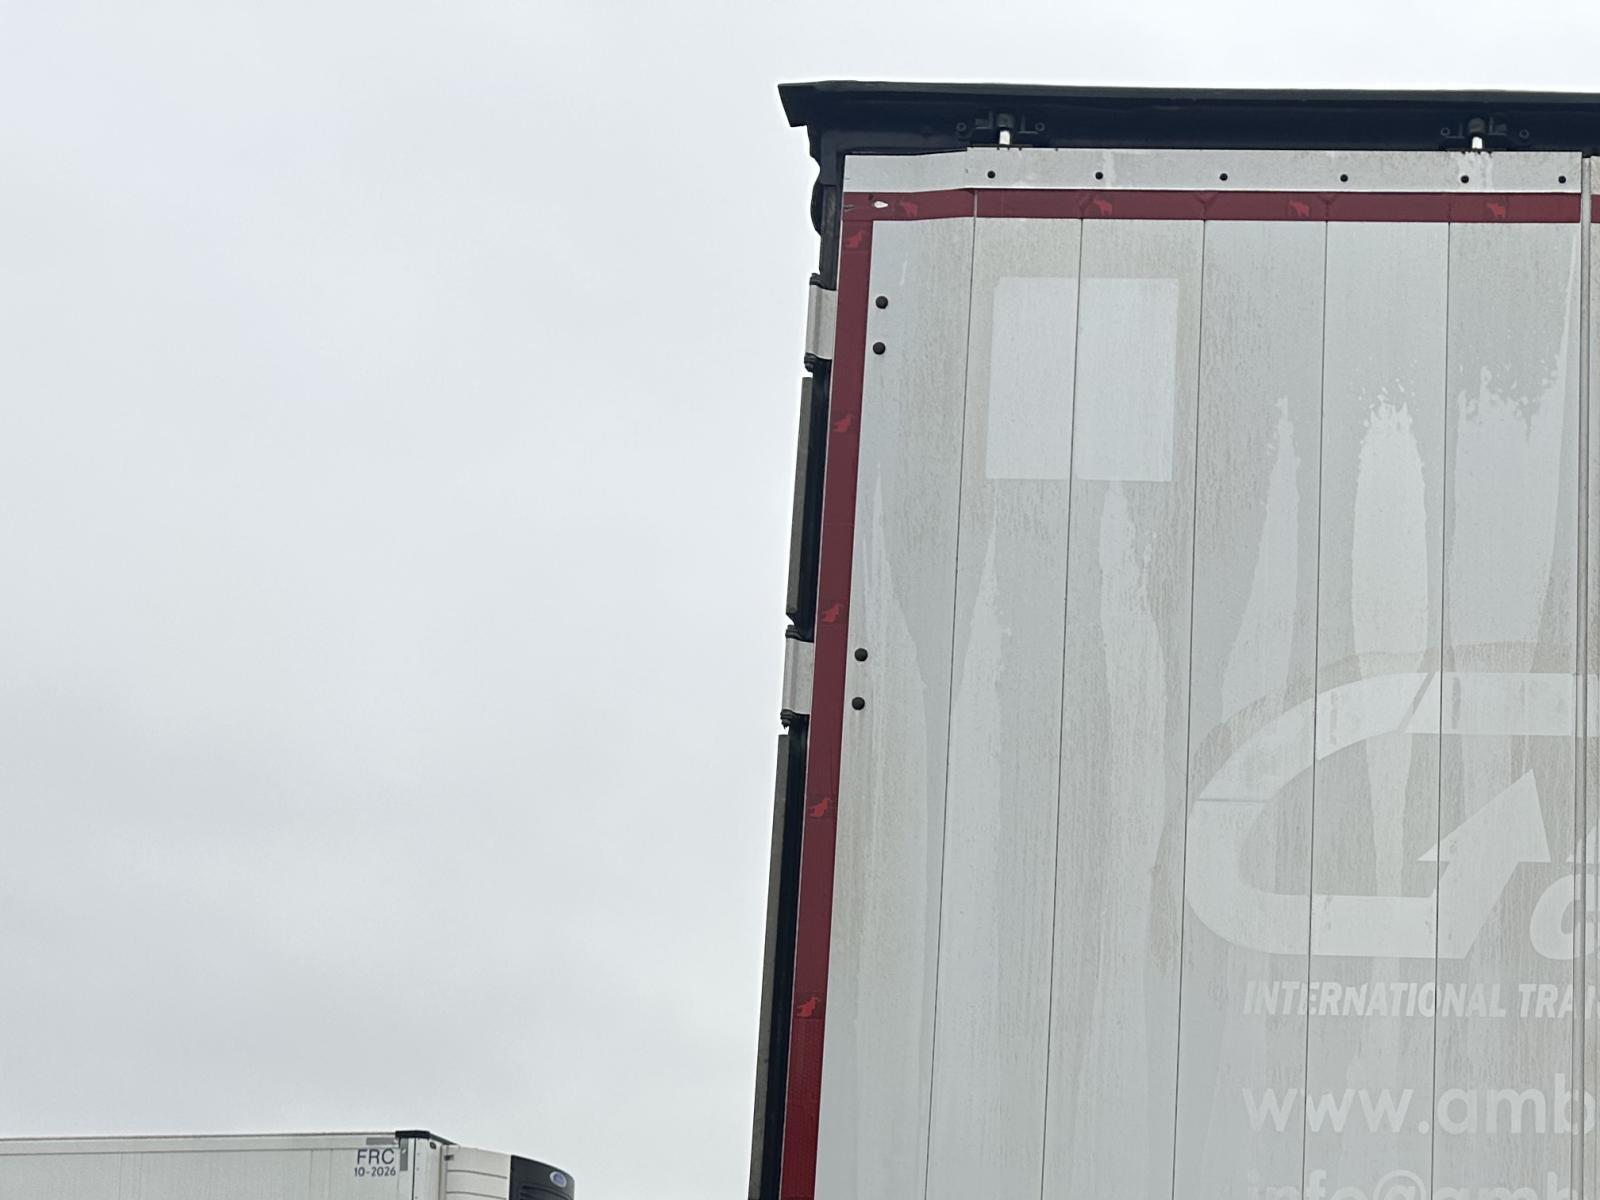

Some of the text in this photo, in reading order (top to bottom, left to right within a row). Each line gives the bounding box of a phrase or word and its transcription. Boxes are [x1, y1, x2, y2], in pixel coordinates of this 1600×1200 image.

[1242, 981, 1506, 1018] INTERNATIONAL
[357, 1148, 394, 1165] FRC
[354, 1166, 396, 1177] 10-2026
